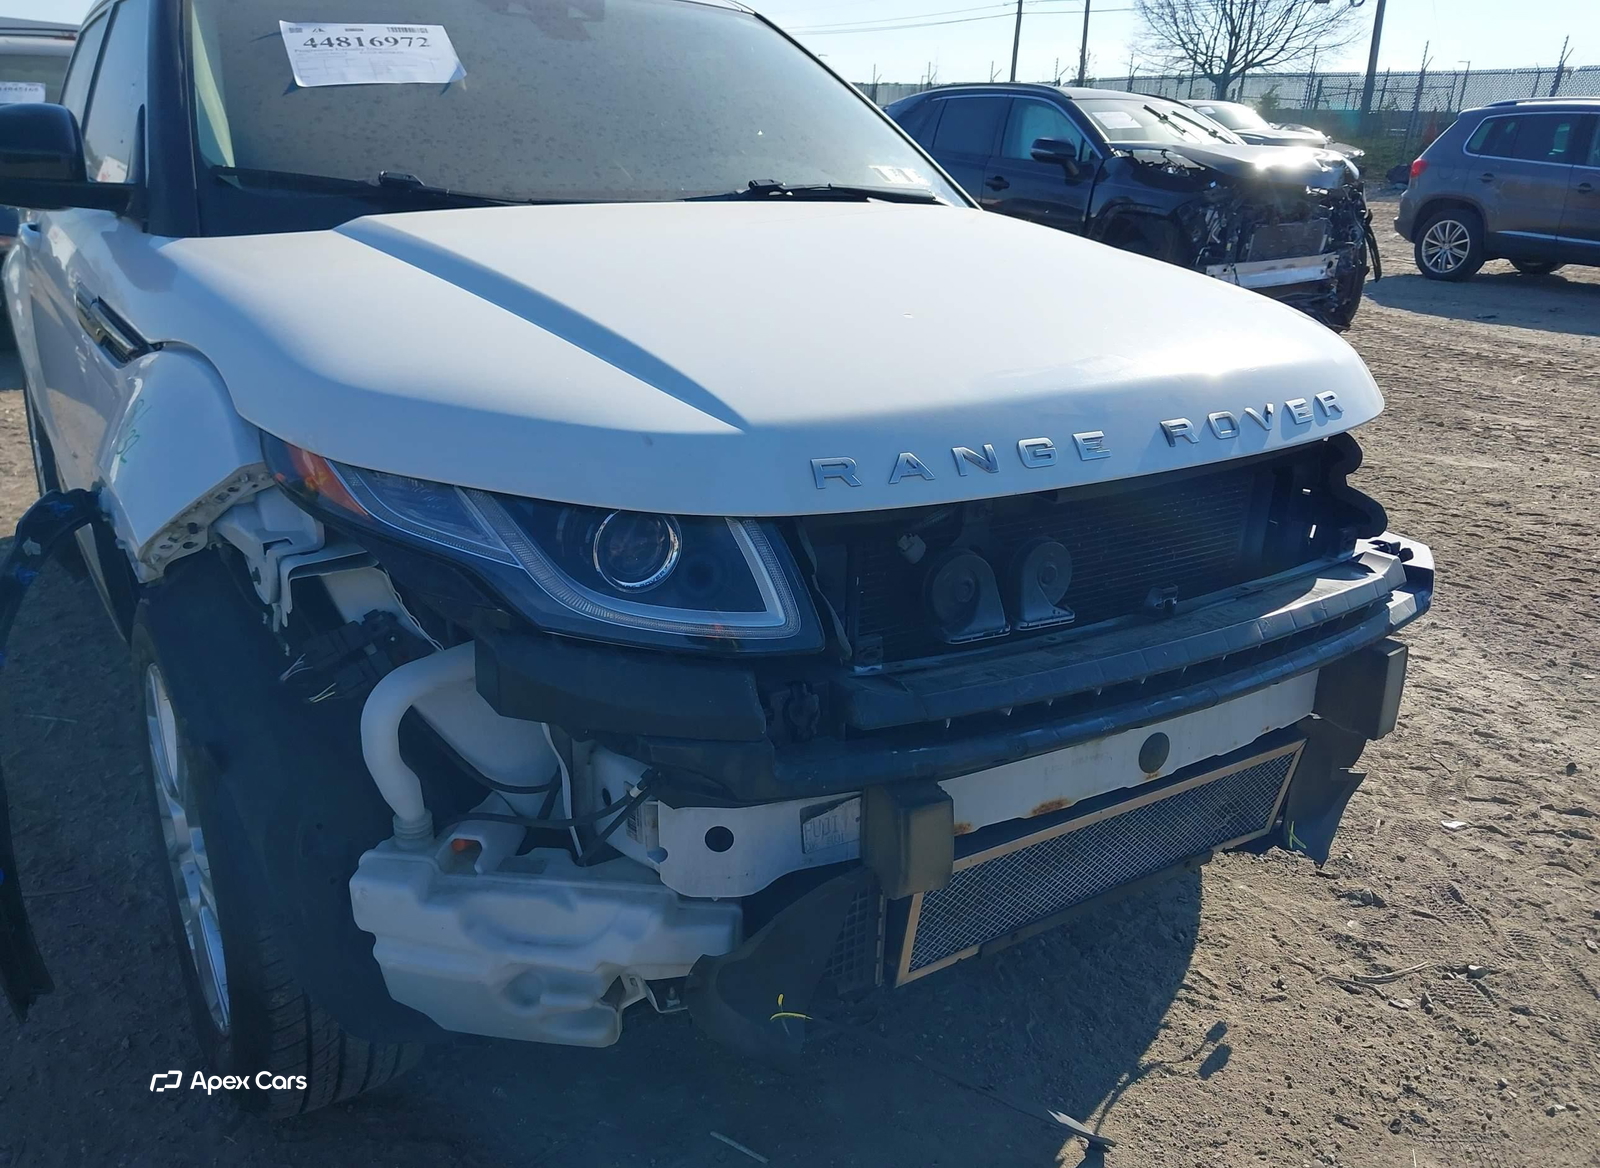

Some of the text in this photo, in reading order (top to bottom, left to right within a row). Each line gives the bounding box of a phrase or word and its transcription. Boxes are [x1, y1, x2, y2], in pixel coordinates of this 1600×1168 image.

[302, 36, 432, 48] 44816972
[810, 389, 1345, 490] RANGE ROVER
